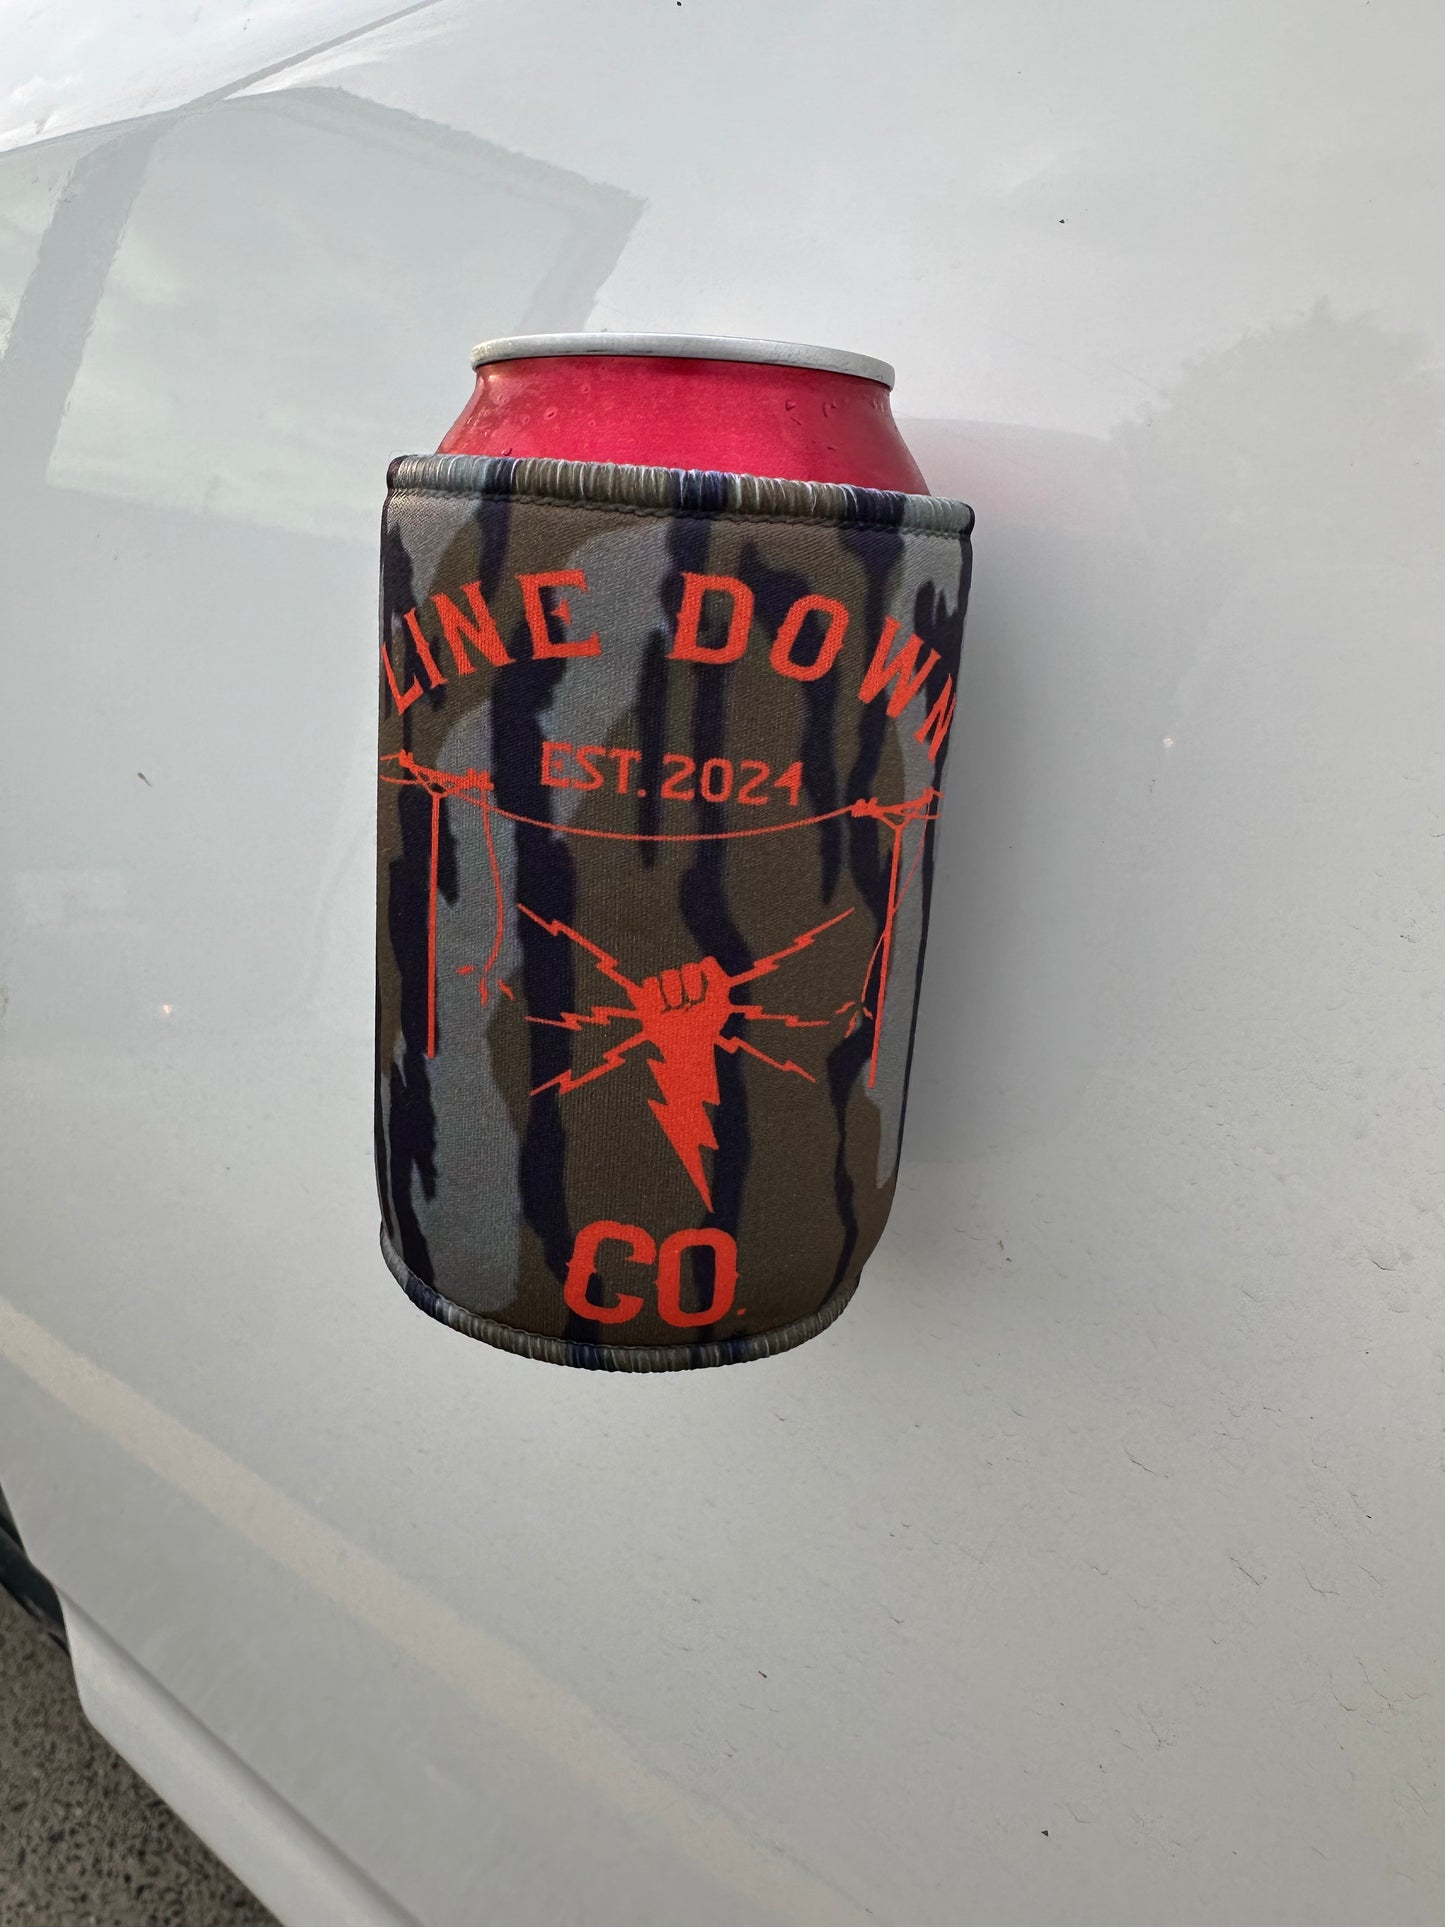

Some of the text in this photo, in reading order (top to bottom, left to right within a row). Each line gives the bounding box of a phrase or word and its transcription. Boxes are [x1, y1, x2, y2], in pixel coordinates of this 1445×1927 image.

[381, 568, 957, 762] LINE DOWN
[563, 1219, 747, 1328] CO.
